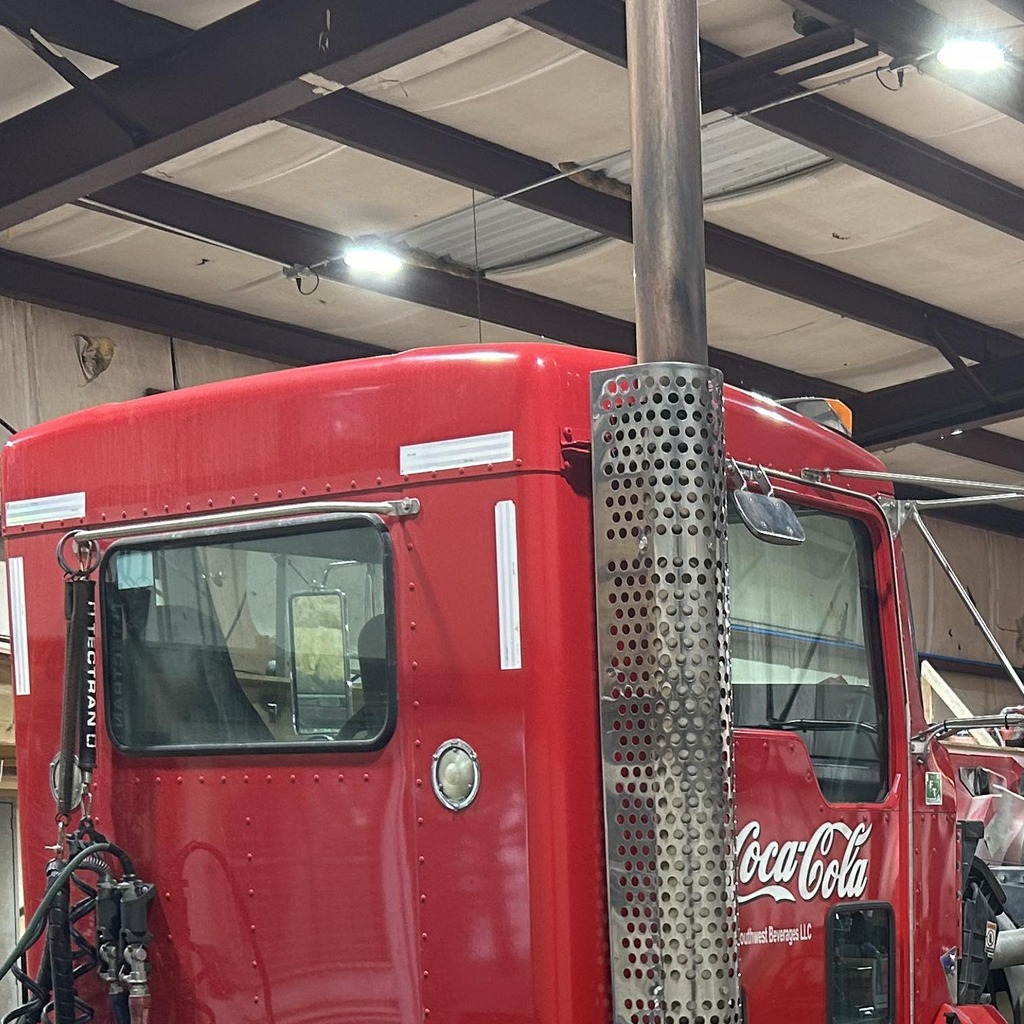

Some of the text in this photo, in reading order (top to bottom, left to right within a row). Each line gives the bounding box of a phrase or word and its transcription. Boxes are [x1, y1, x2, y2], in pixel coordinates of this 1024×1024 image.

[86, 623, 96, 727] TECTRAN
[768, 925, 799, 946] Beverages
[799, 922, 812, 941] LLC
